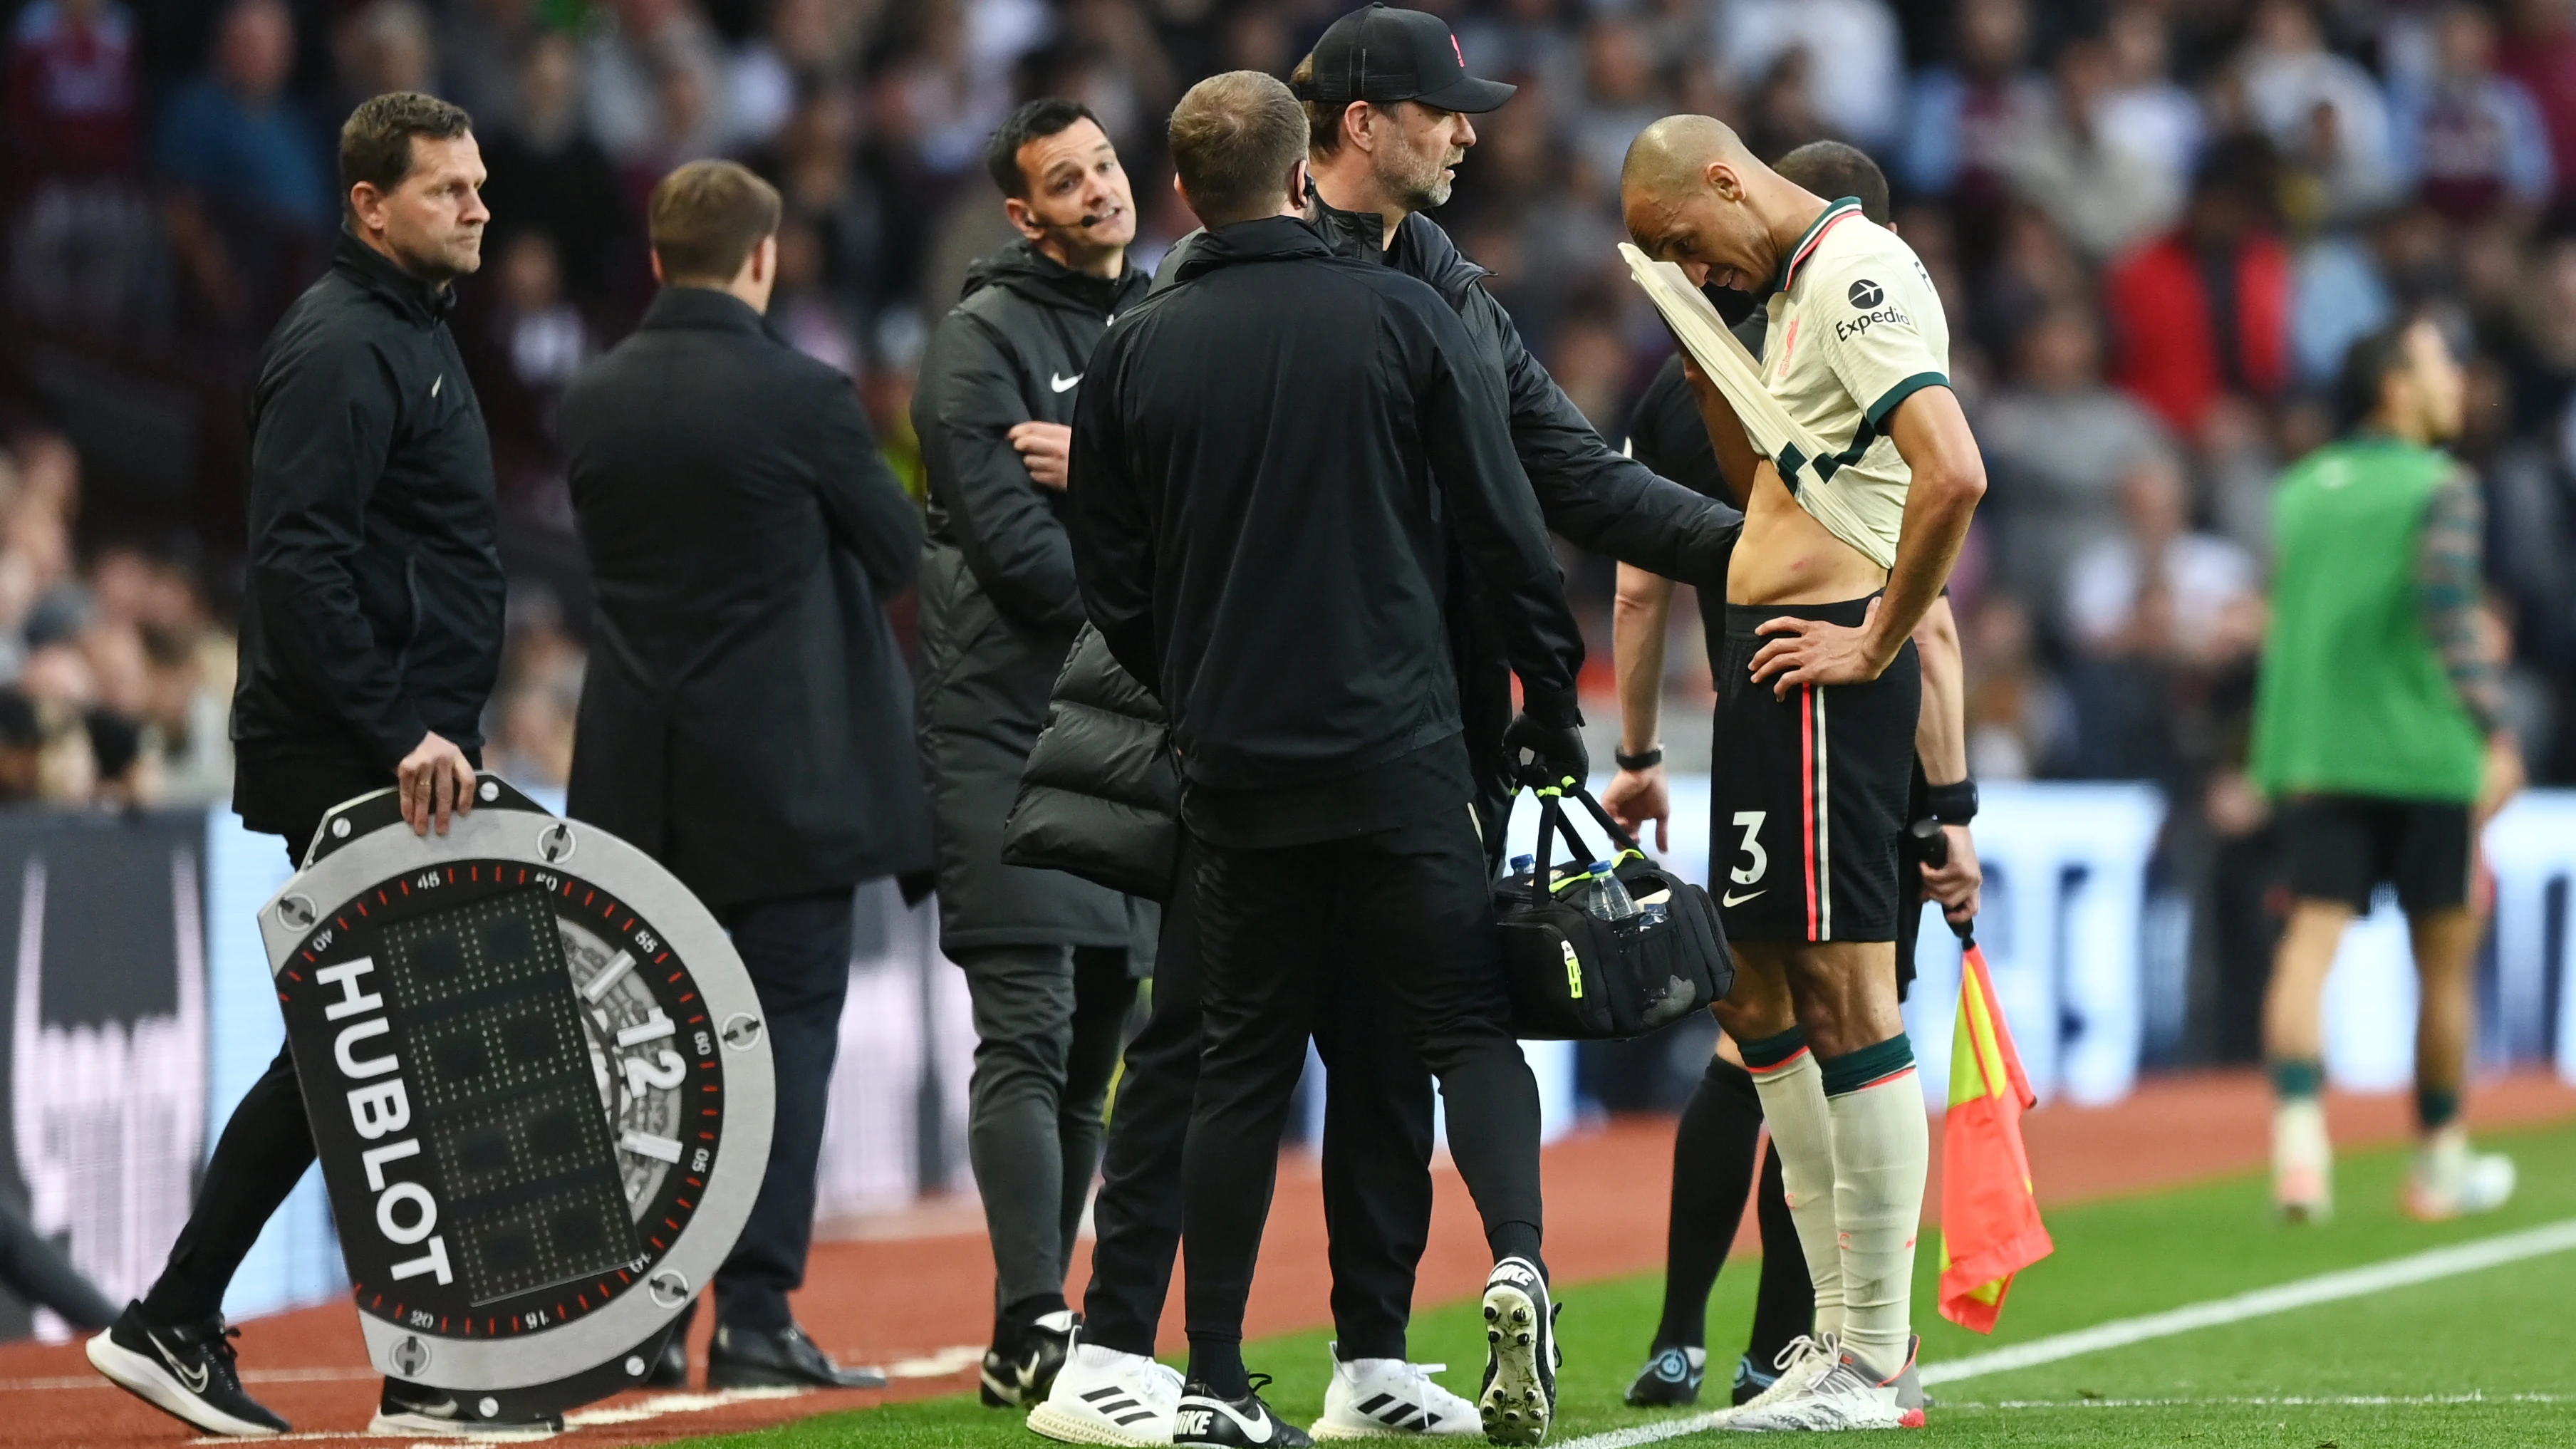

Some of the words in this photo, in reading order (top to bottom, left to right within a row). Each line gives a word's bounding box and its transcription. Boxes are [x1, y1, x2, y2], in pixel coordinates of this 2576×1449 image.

[1835, 306, 1911, 342] Expedia
[1730, 811, 1767, 885] 3
[417, 871, 440, 889] 45
[312, 928, 333, 952] 40
[635, 929, 658, 953] 55
[617, 1007, 687, 1098] 12
[693, 1031, 712, 1055] 60
[316, 957, 452, 1286] HUBLOT
[691, 1147, 710, 1173] 05
[1486, 1264, 1534, 1287] NIKE
[409, 1309, 434, 1329] 20
[524, 1309, 550, 1330] 15
